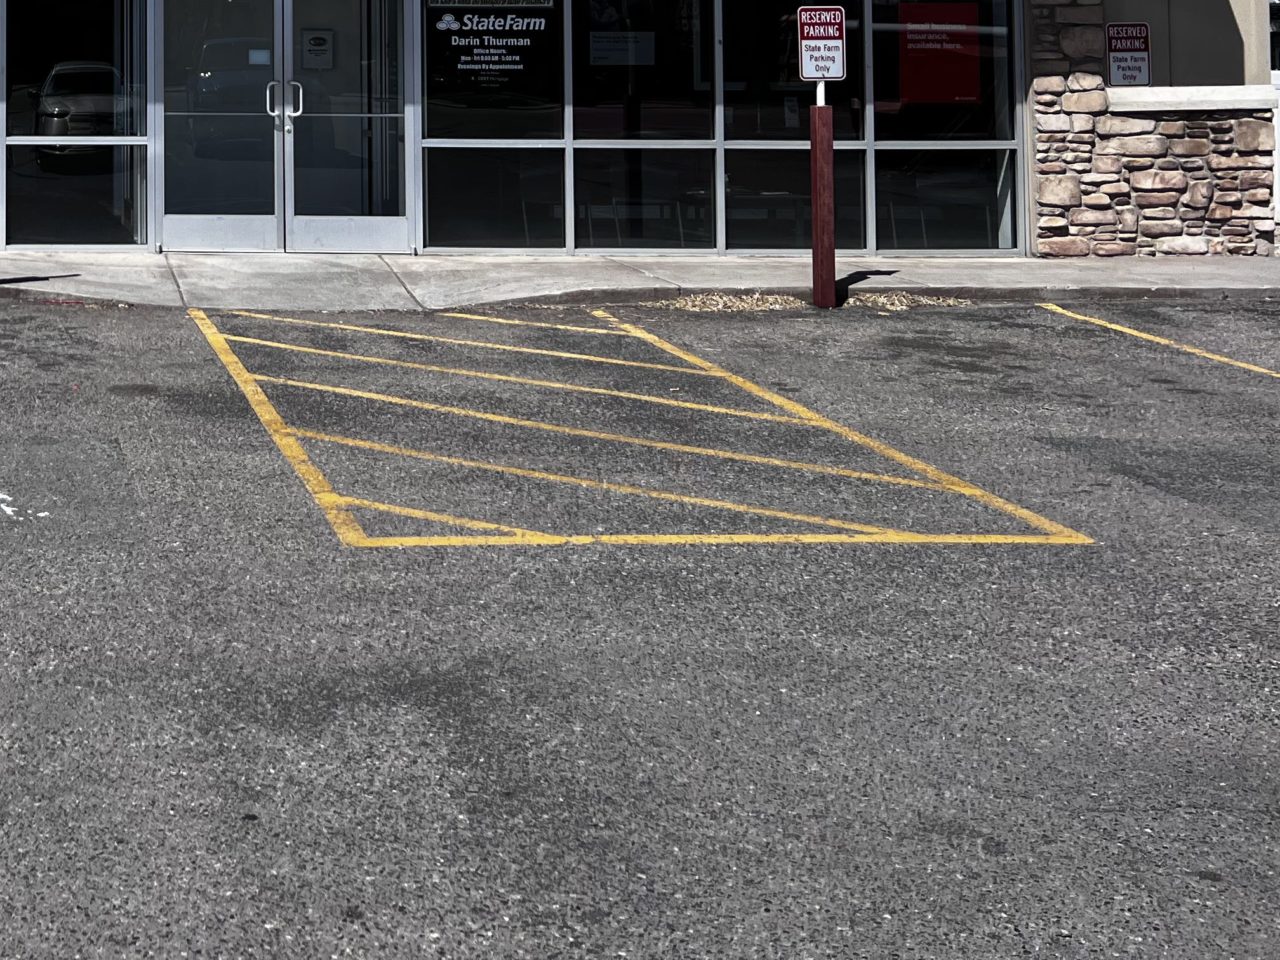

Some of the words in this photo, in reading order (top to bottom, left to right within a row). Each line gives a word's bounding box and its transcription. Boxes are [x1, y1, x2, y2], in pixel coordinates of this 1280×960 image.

[801, 11, 841, 23] RESERVED
[803, 25, 840, 37] PARKING
[1109, 26, 1147, 38] RESERVED
[451, 35, 480, 47] Darin
[482, 35, 531, 47] Thurman
[1111, 39, 1145, 50] PARKING
[804, 44, 822, 52] State
[823, 44, 840, 52] Farm
[809, 54, 836, 64] Parking
[1112, 55, 1129, 63] State
[1130, 55, 1147, 63] Farm
[814, 64, 831, 74] Only
[1116, 64, 1142, 73] Parking
[1122, 73, 1137, 81] Only
